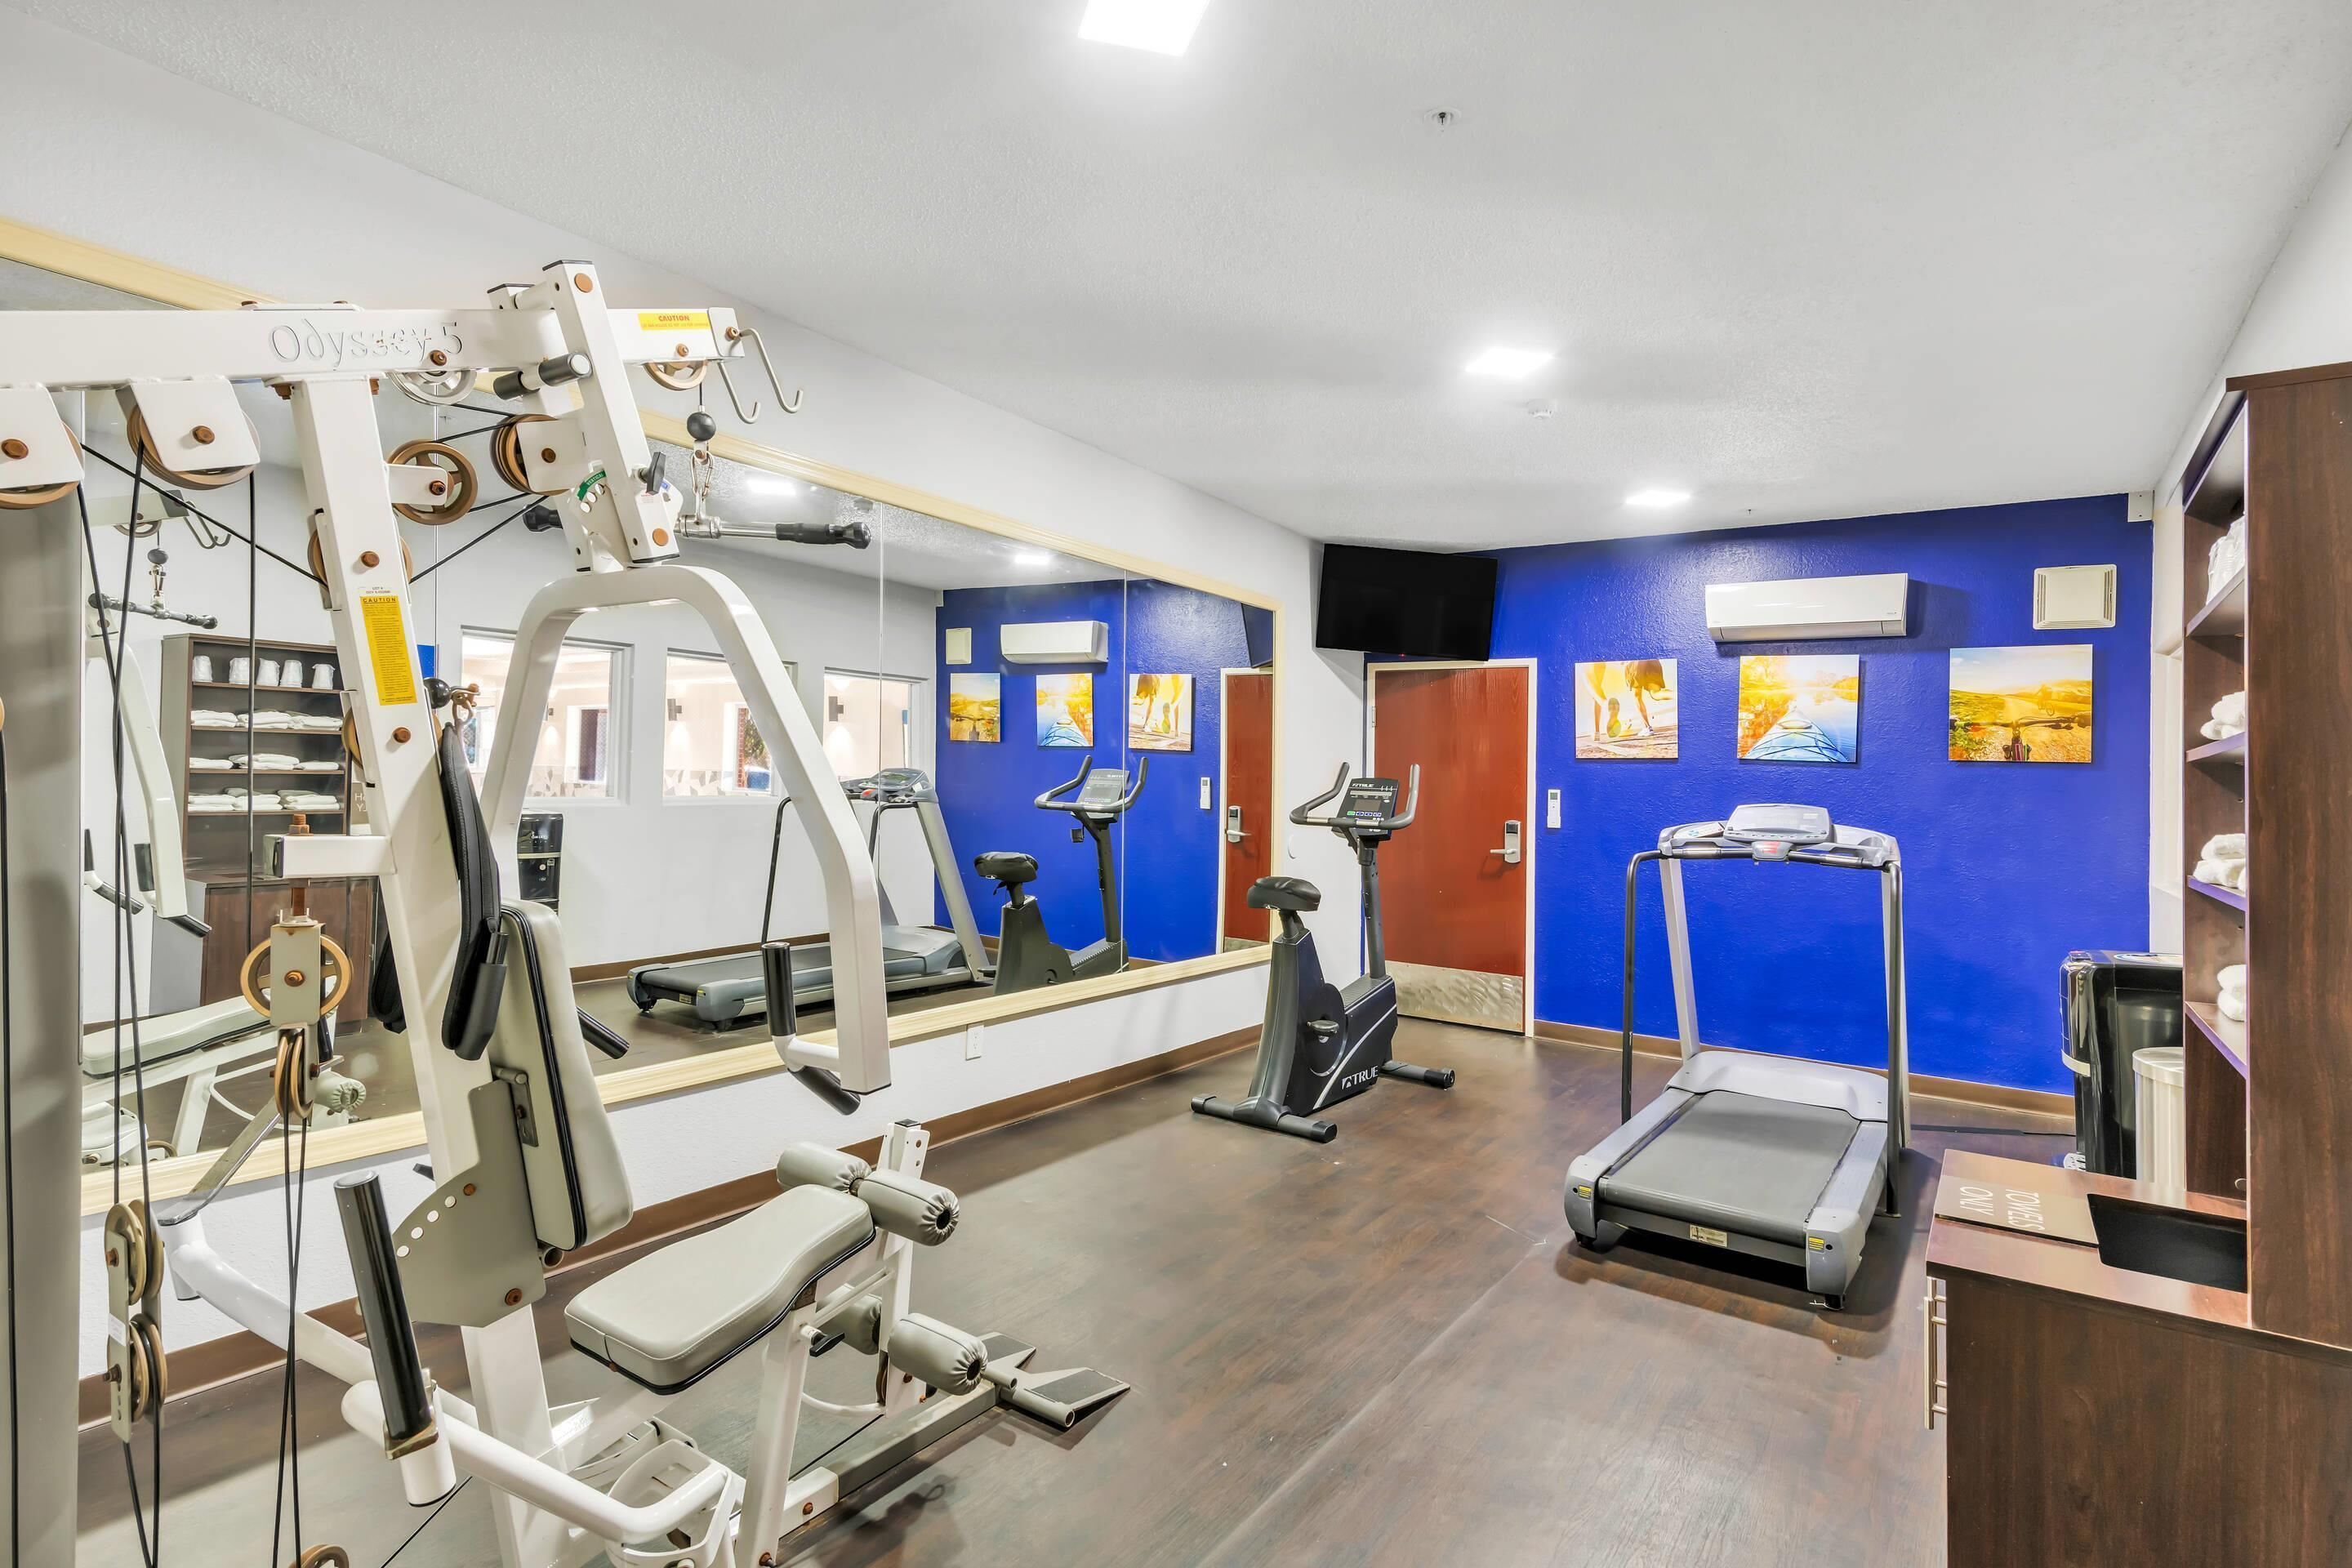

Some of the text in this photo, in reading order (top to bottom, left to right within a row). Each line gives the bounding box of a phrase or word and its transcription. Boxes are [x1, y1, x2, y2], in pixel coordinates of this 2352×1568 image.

[269, 317, 463, 368] Odyssey 5
[1352, 1065, 1379, 1085] TRUE
[1960, 1186, 1994, 1216] ONLY
[2005, 1188, 2046, 1231] TOWELS
